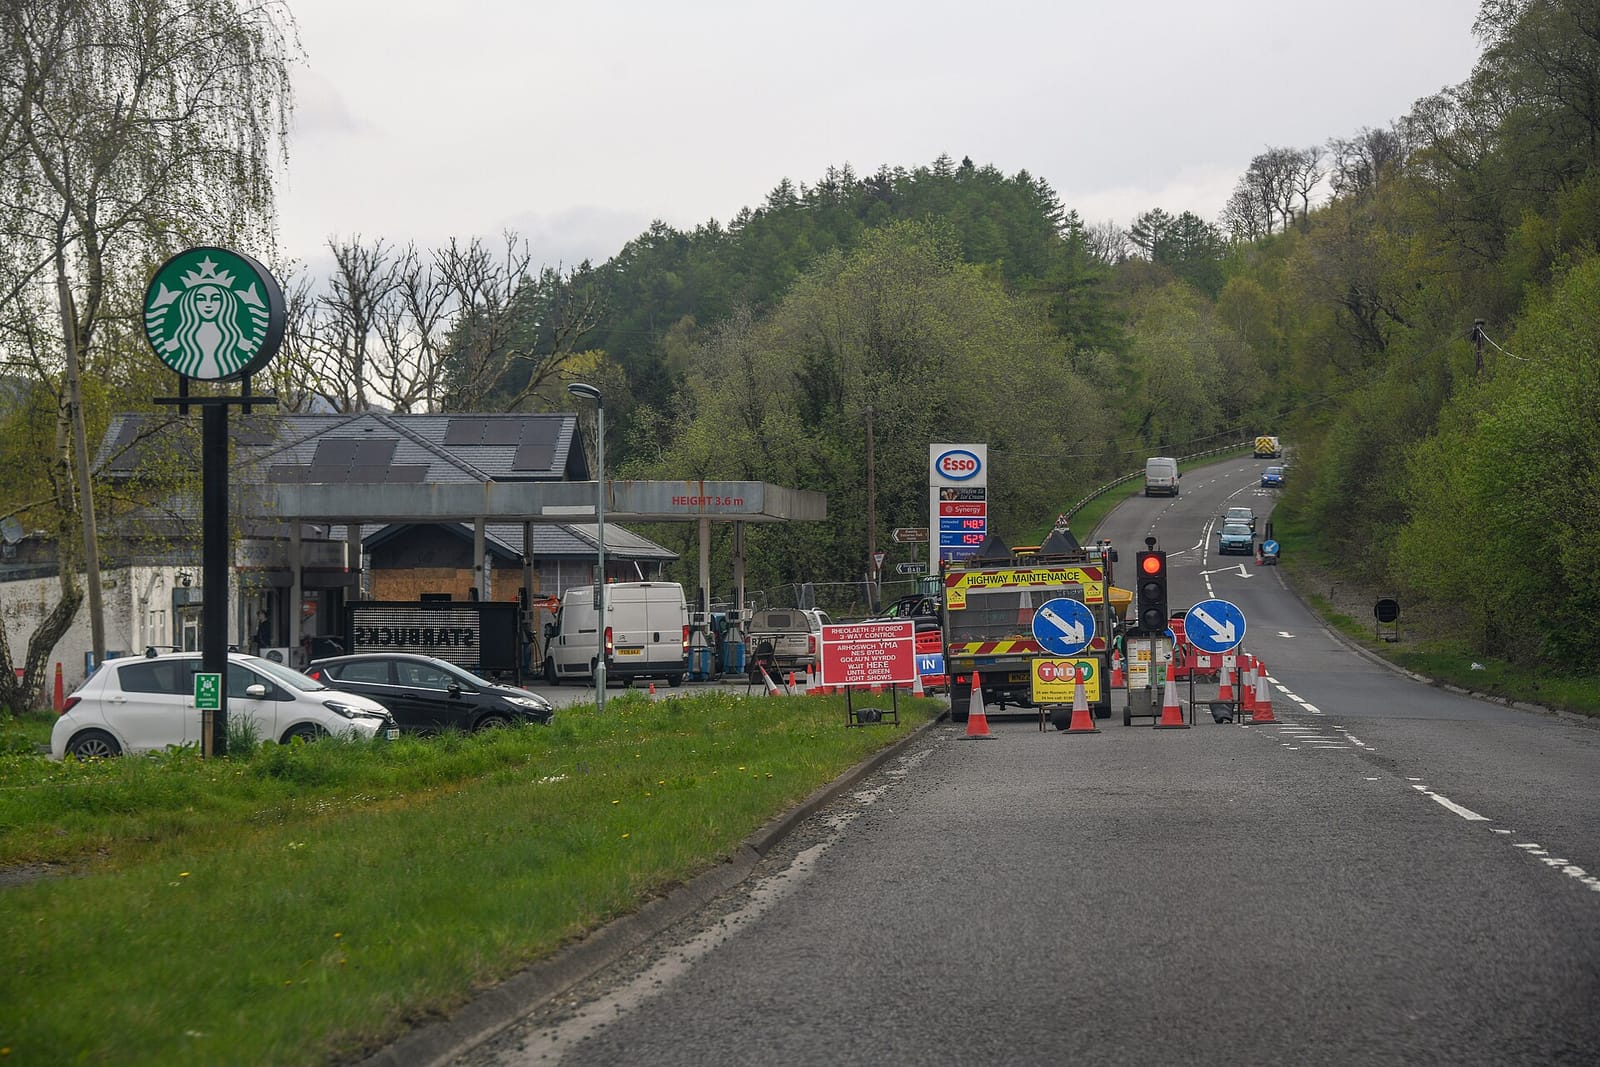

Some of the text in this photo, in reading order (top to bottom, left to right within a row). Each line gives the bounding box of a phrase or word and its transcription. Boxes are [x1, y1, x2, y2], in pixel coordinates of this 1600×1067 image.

[943, 457, 975, 471] Esso
[672, 496, 744, 506] HEIGHT 3.6 m
[954, 505, 981, 514] Synergy
[967, 571, 1080, 585] HIGHWAY MAINTENANCE
[831, 626, 869, 634] RHEOLAETH
[837, 643, 876, 651] ARHOSWCH
[866, 661, 889, 669] HERE
[922, 659, 936, 670] IN
